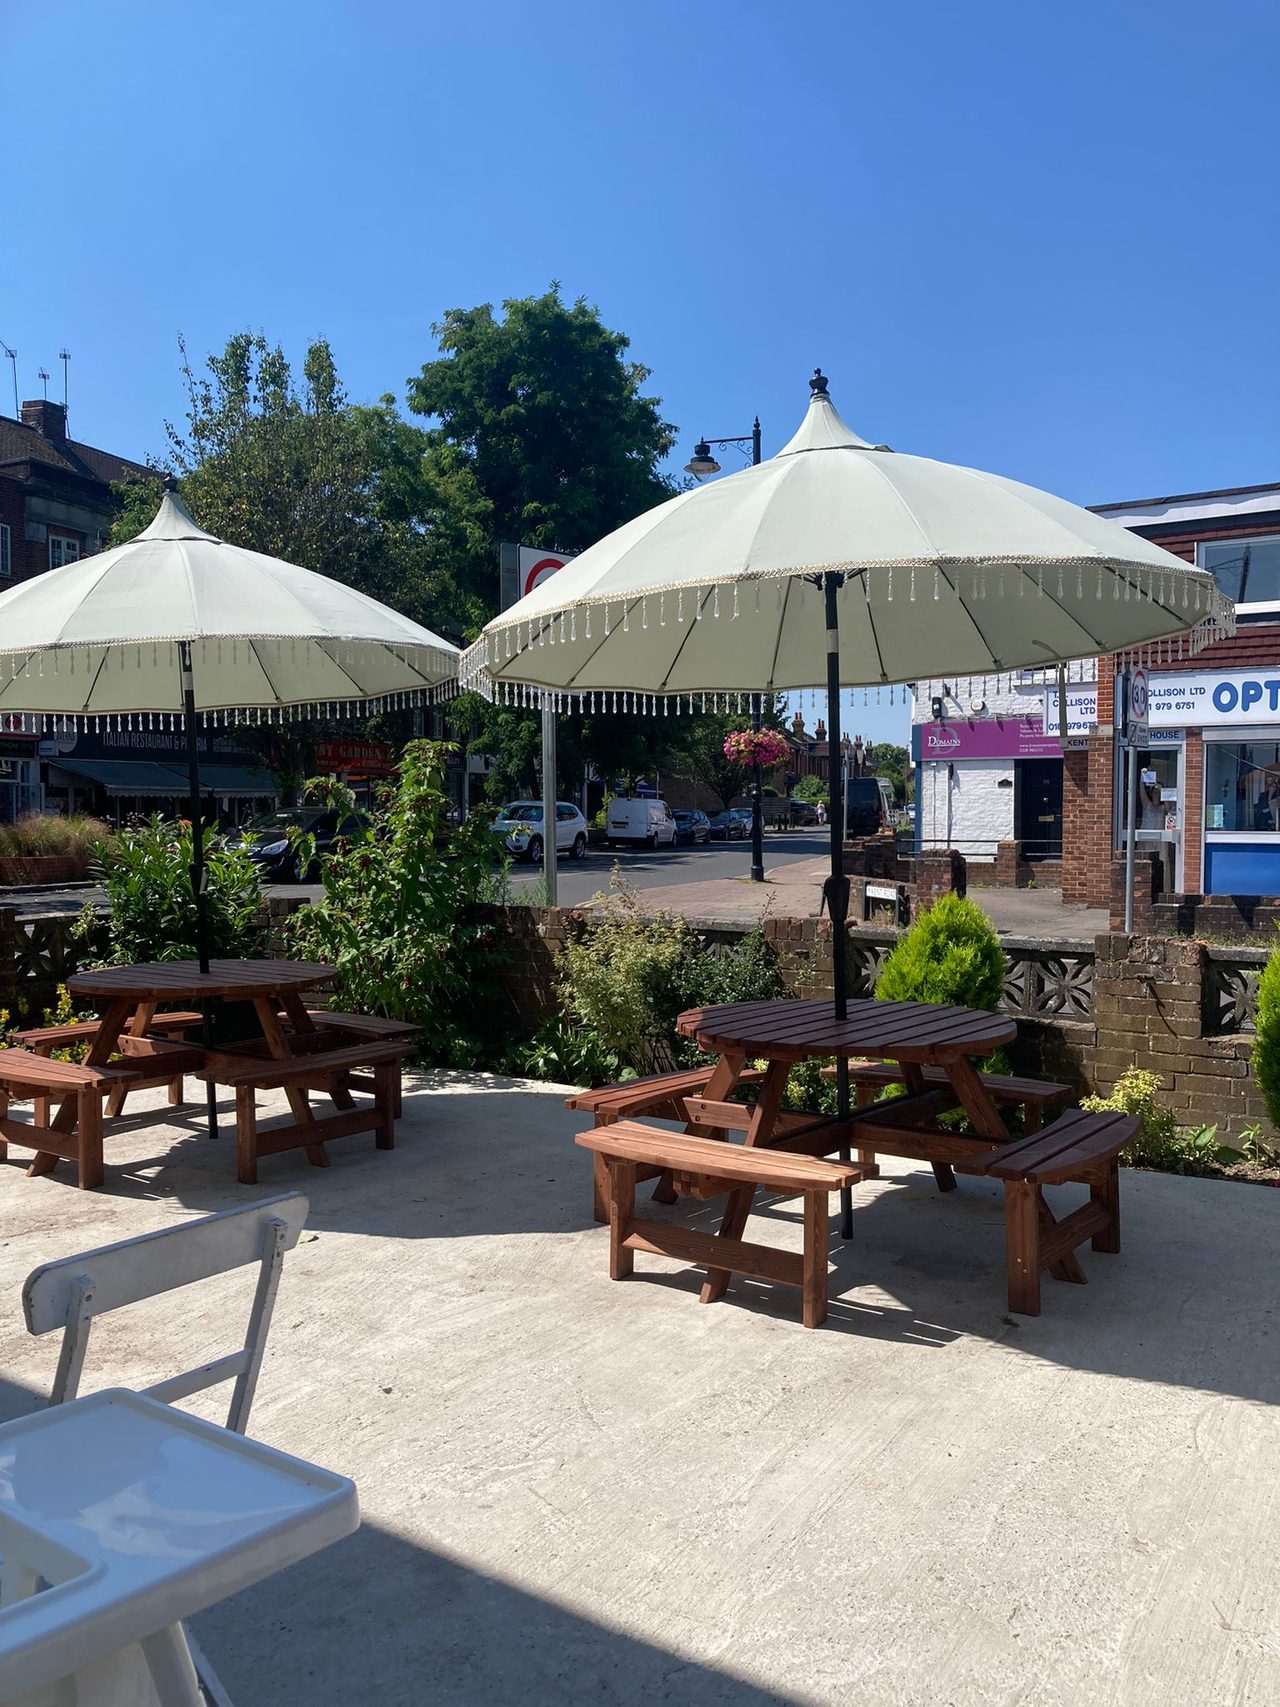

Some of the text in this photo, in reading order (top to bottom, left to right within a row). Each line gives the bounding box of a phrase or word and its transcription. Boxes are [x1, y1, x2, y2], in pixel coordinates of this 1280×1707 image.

[1134, 685, 1145, 704] 30
[1148, 687, 1206, 697] OLLISON LTD
[1211, 680, 1280, 713] OPT
[1052, 698, 1096, 707] CLLISON
[1155, 702, 1172, 711] 979
[1175, 701, 1195, 710] 6751
[1080, 707, 1096, 715] LTD
[1150, 731, 1180, 739] HOUSE
[102, 731, 130, 747] ITALIAN
[131, 733, 173, 750] RESTAURANT
[174, 735, 179, 750] &
